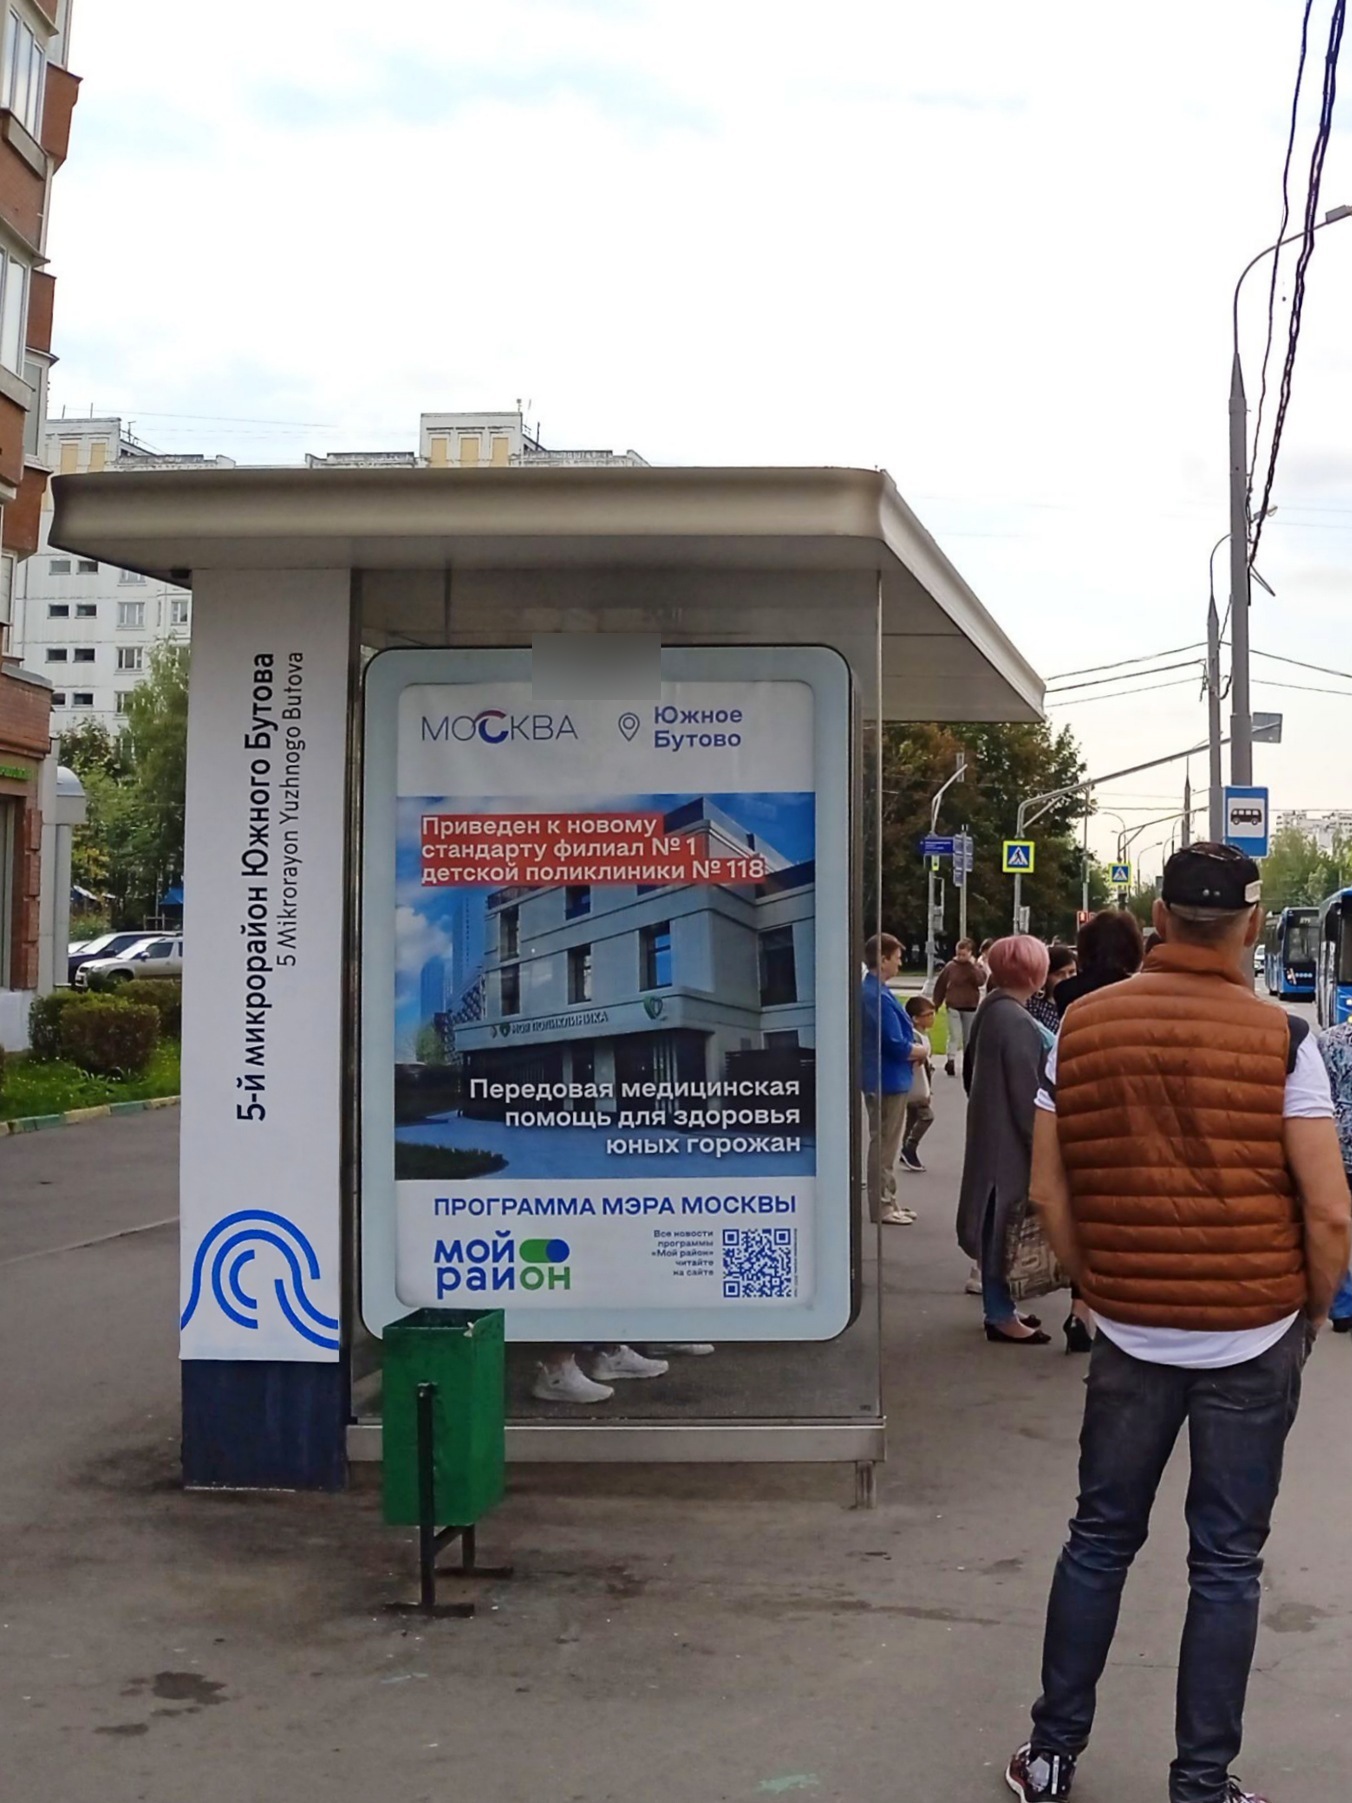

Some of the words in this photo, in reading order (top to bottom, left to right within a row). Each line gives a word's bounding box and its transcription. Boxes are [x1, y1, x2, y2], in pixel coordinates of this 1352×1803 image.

[282, 653, 303, 719] Butova
[245, 654, 278, 748] Бутова
[655, 706, 742, 724] Южное
[421, 709, 580, 745] МОСКВА
[655, 730, 741, 752] Бутово
[279, 727, 305, 824] Yuzhnogo
[242, 759, 270, 876] Южного
[423, 816, 541, 840] Приведен
[546, 819, 562, 837] к
[566, 820, 658, 840] новому
[422, 841, 547, 861] стандарту
[552, 837, 645, 862] филиал
[650, 836, 682, 857] №
[685, 836, 697, 857] 1
[422, 860, 520, 885] детской
[526, 862, 686, 882] поликлиники
[691, 858, 722, 880] №
[727, 857, 766, 880] 118
[277, 831, 302, 949] Mikrorayon
[277, 955, 296, 966] 5
[241, 887, 273, 1066] микрорайон
[237, 1075, 265, 1121] 5-й
[468, 1077, 616, 1104] Передовая
[620, 1076, 800, 1101] медицинская
[504, 1107, 612, 1128] помощь
[617, 1106, 667, 1127] для
[673, 1105, 801, 1130] здоровья
[606, 1136, 680, 1156] юных
[685, 1136, 801, 1157] горожан
[435, 1198, 596, 1216] ПРОГРАММА
[603, 1197, 675, 1215] МЭРА
[682, 1195, 795, 1214] МОСКВЫ
[434, 1230, 514, 1263] мой
